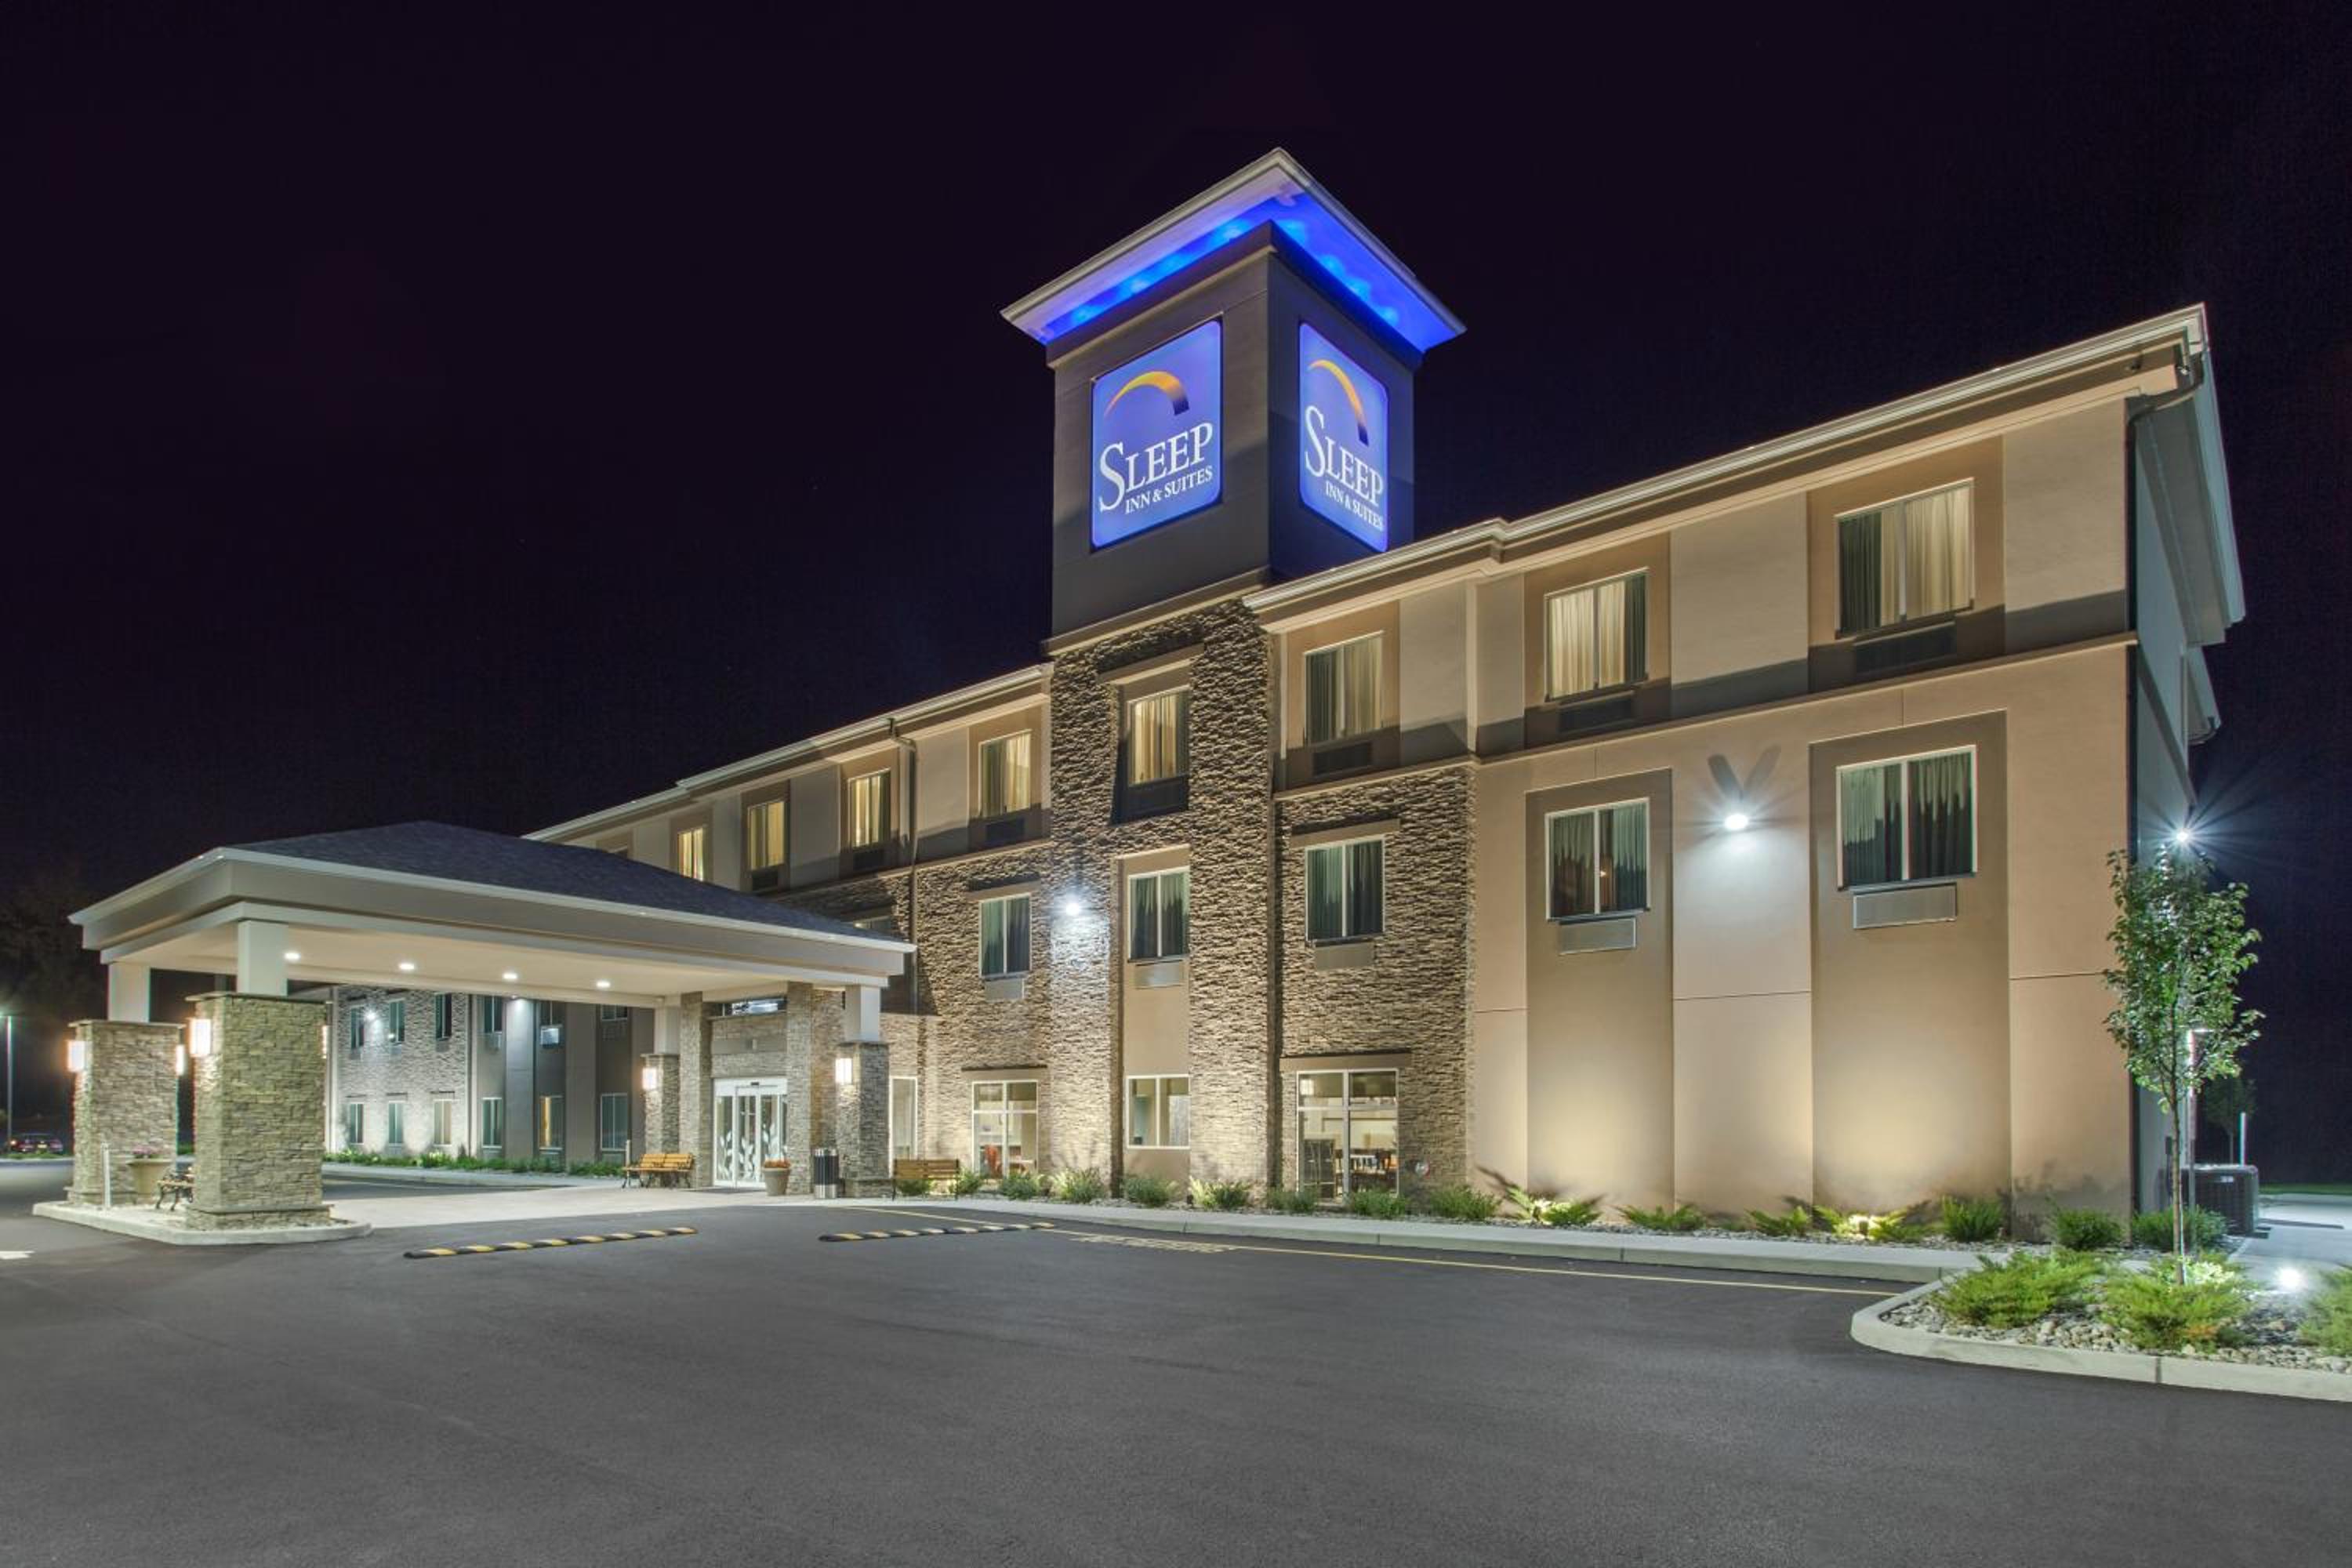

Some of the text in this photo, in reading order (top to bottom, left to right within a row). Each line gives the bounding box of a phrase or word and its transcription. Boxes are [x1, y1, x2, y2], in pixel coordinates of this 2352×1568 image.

[1099, 423, 1213, 512] SLEEP
[1126, 465, 1213, 514] INN & SUITES
[1305, 405, 1383, 506] SLEEP
[1326, 480, 1383, 532] INN & SUITES
